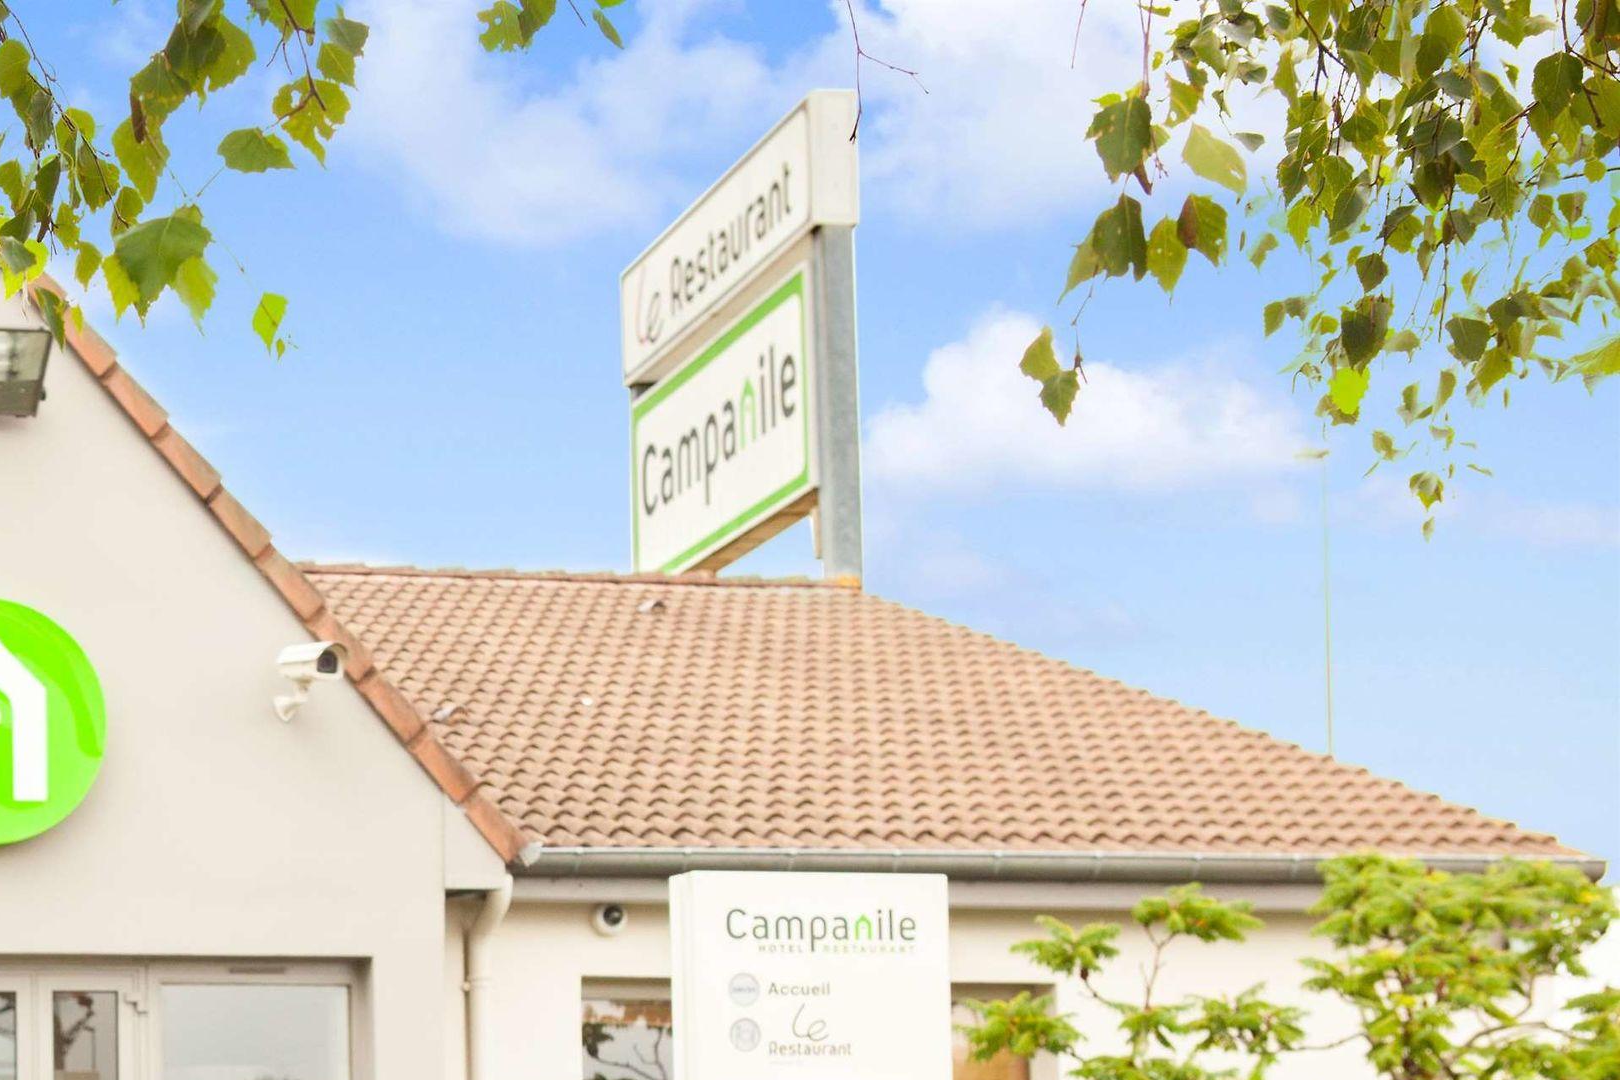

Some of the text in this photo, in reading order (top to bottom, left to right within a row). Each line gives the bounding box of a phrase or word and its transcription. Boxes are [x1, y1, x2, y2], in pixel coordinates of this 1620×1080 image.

[671, 160, 792, 308] Restaurant
[642, 344, 797, 516] Campanile
[726, 908, 916, 952] Campanile
[758, 945, 916, 953] HOTEL RESTAURANT
[768, 982, 830, 996] Accueil
[768, 1040, 851, 1056] Restaurant
